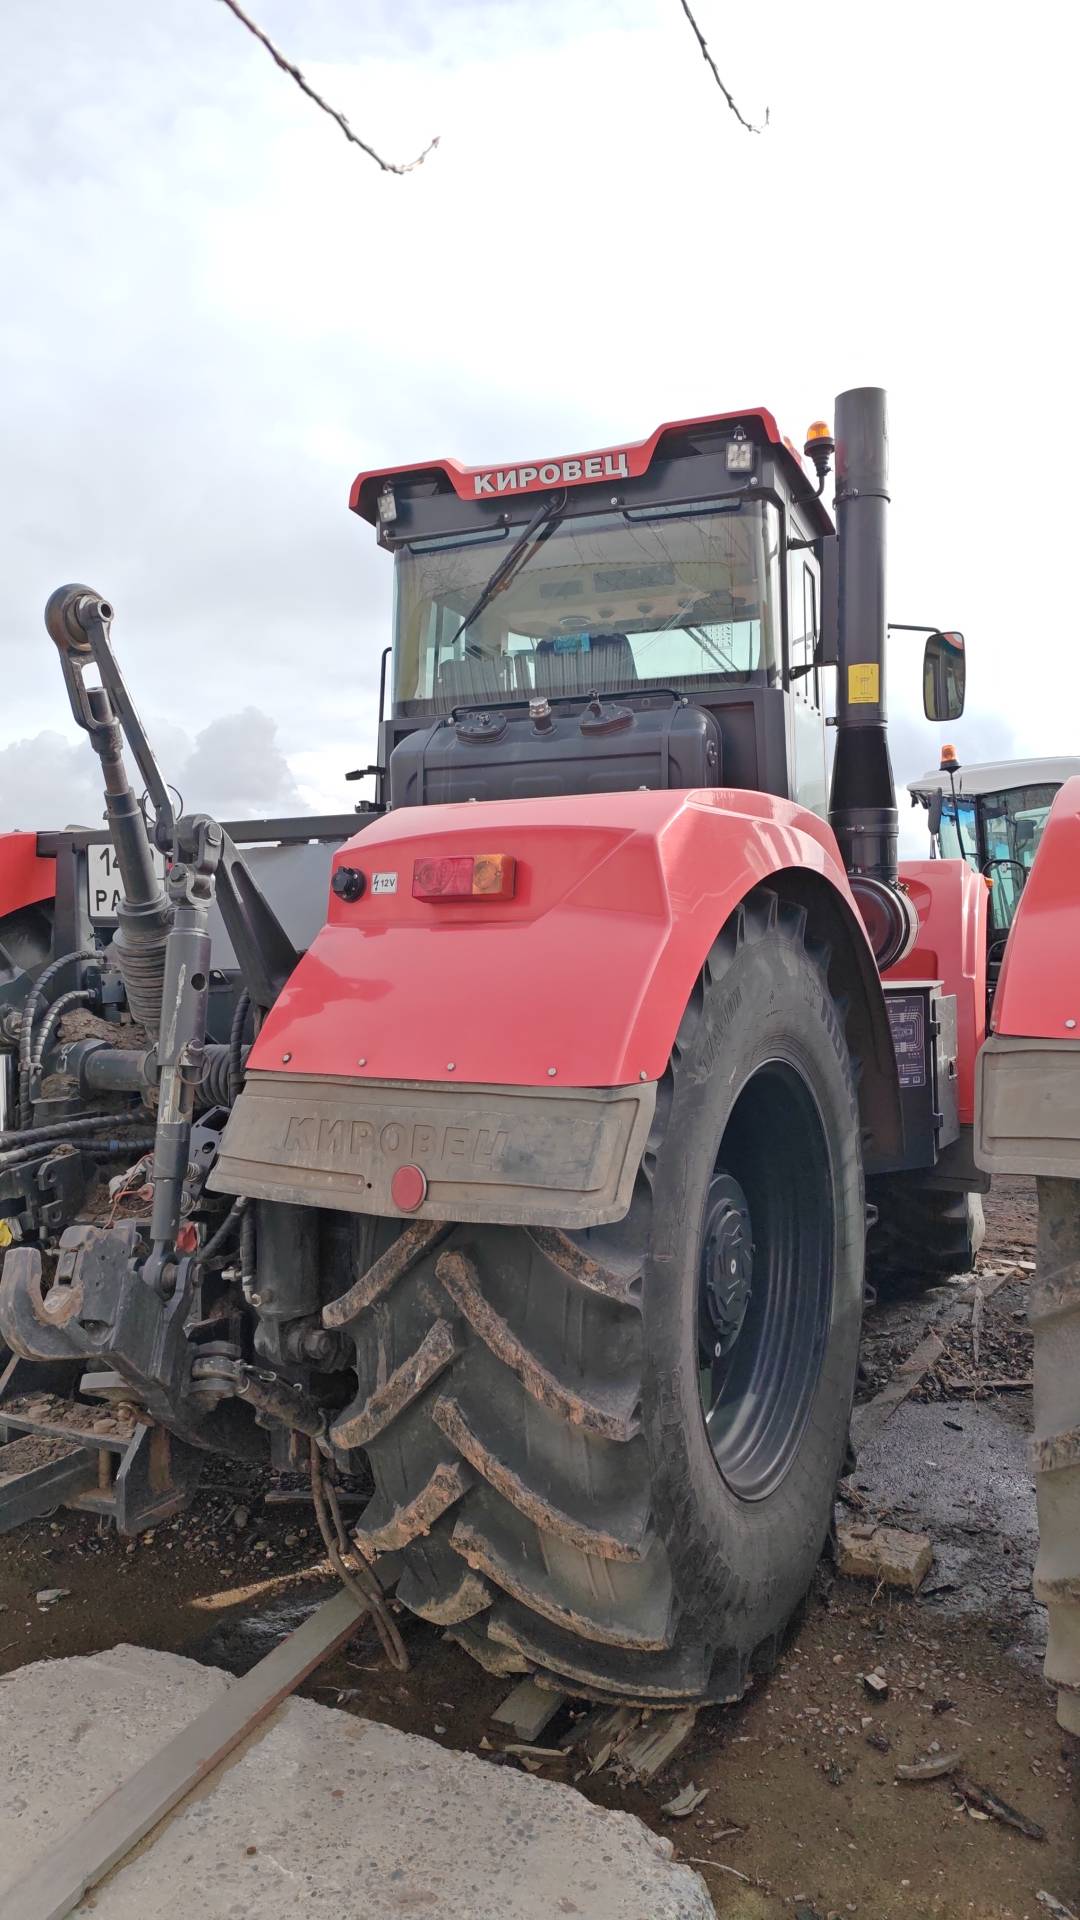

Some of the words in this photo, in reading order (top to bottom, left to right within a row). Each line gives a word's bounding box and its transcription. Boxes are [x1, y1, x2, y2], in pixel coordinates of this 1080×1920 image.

[474, 453, 628, 495] КИРОВЕЦ
[380, 877, 395, 888] 12V
[283, 1116, 509, 1171] КИРОВЕЦ
